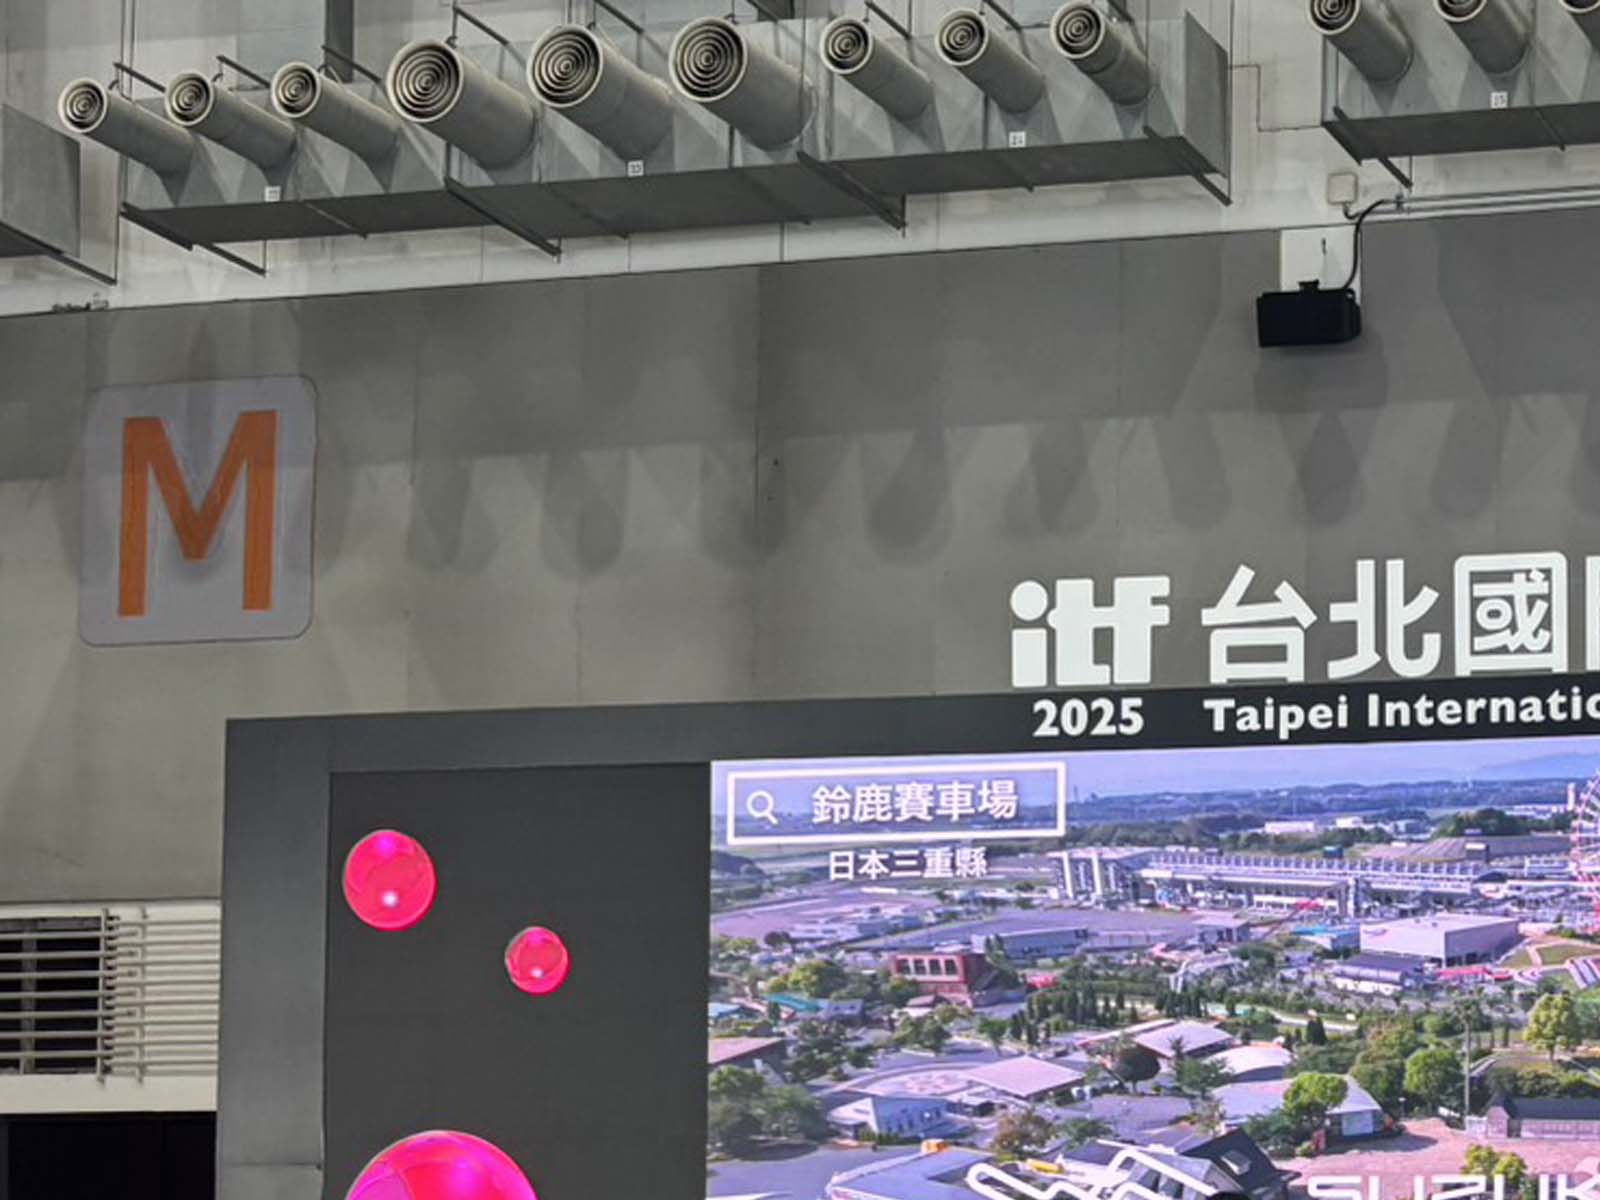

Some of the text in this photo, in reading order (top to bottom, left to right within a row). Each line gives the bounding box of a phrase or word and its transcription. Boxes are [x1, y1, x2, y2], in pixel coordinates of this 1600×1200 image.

[118, 409, 277, 617] M
[1010, 575, 1170, 688] itf
[1033, 697, 1145, 737] 2025
[1203, 694, 1349, 740] Taipei
[811, 779, 1018, 824] 鈴鹿賽車場
[829, 846, 987, 881] 日本三重縣
